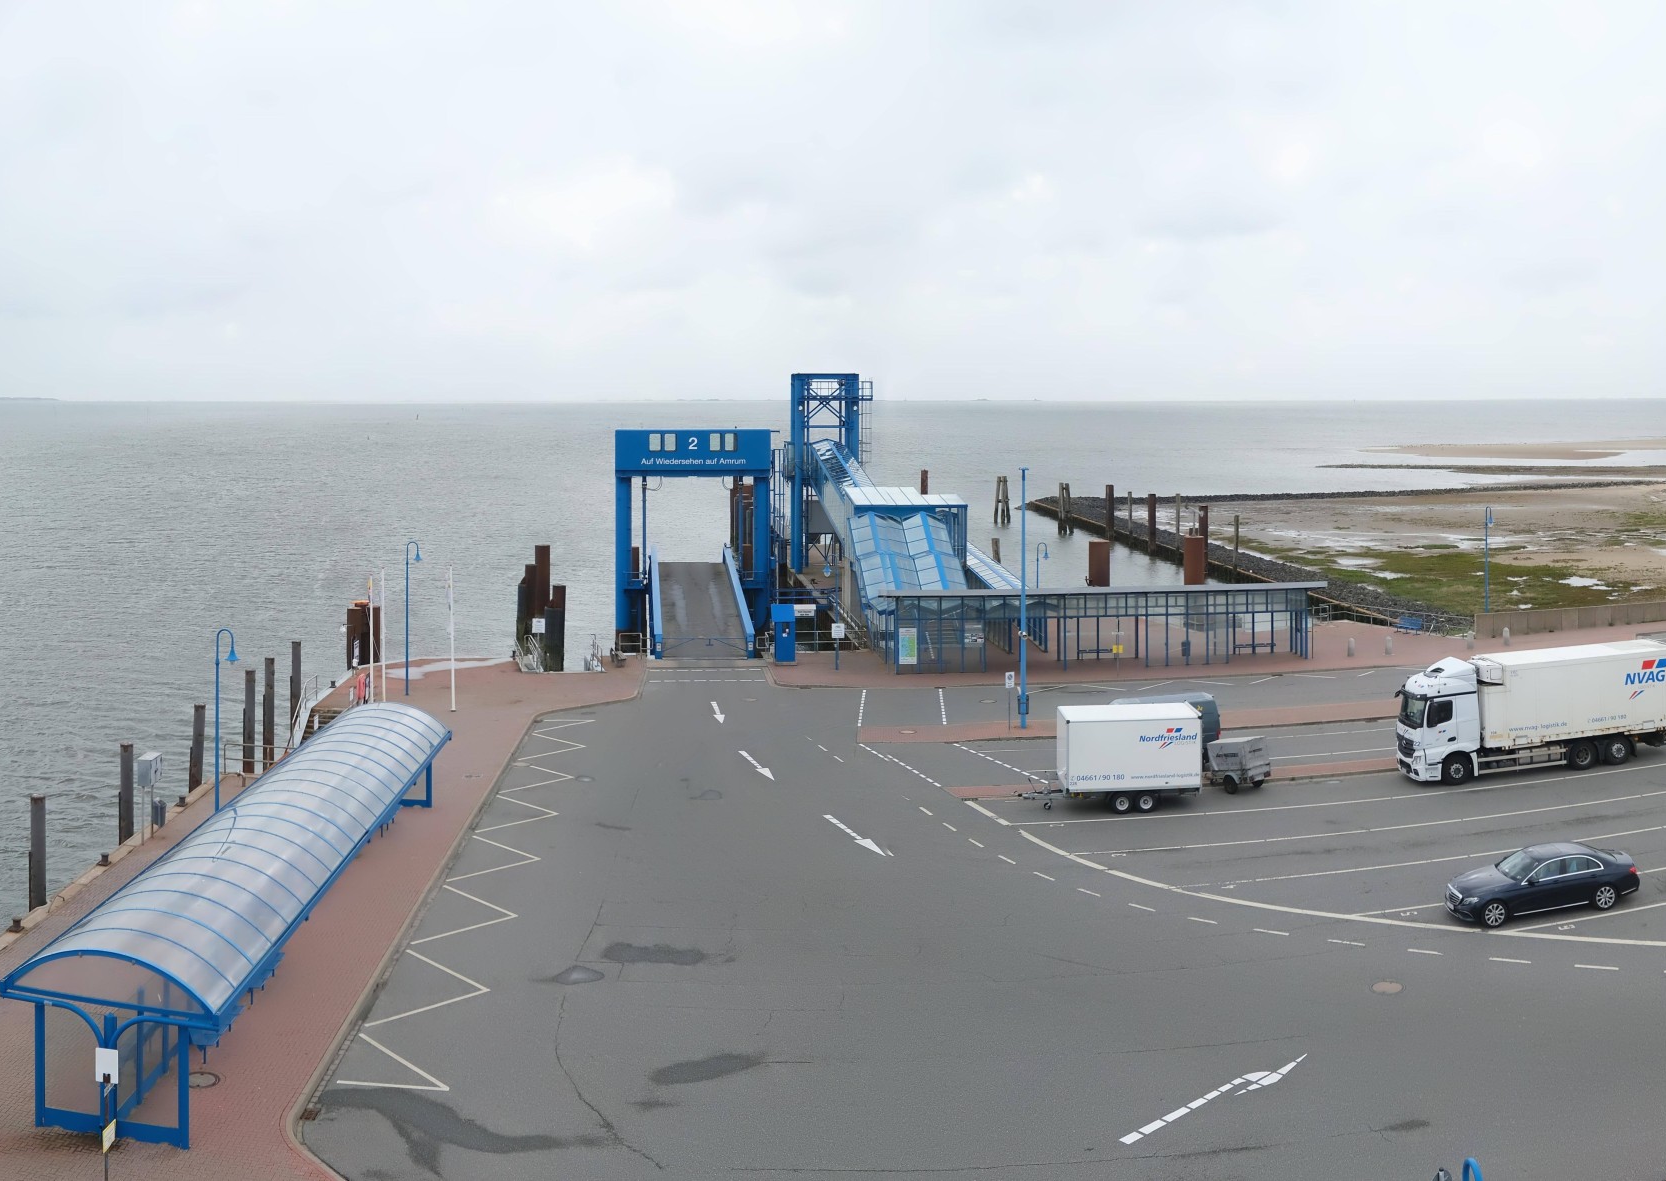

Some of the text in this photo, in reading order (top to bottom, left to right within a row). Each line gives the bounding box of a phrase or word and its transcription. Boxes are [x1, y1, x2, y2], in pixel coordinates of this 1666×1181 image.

[688, 437, 698, 450] 2
[655, 457, 704, 465] Wiedersehen
[719, 457, 746, 465] Amrum
[1624, 669, 1666, 686] NVAG
[1138, 733, 1198, 742] Nordfriesland
[1112, 773, 1125, 781] 180
